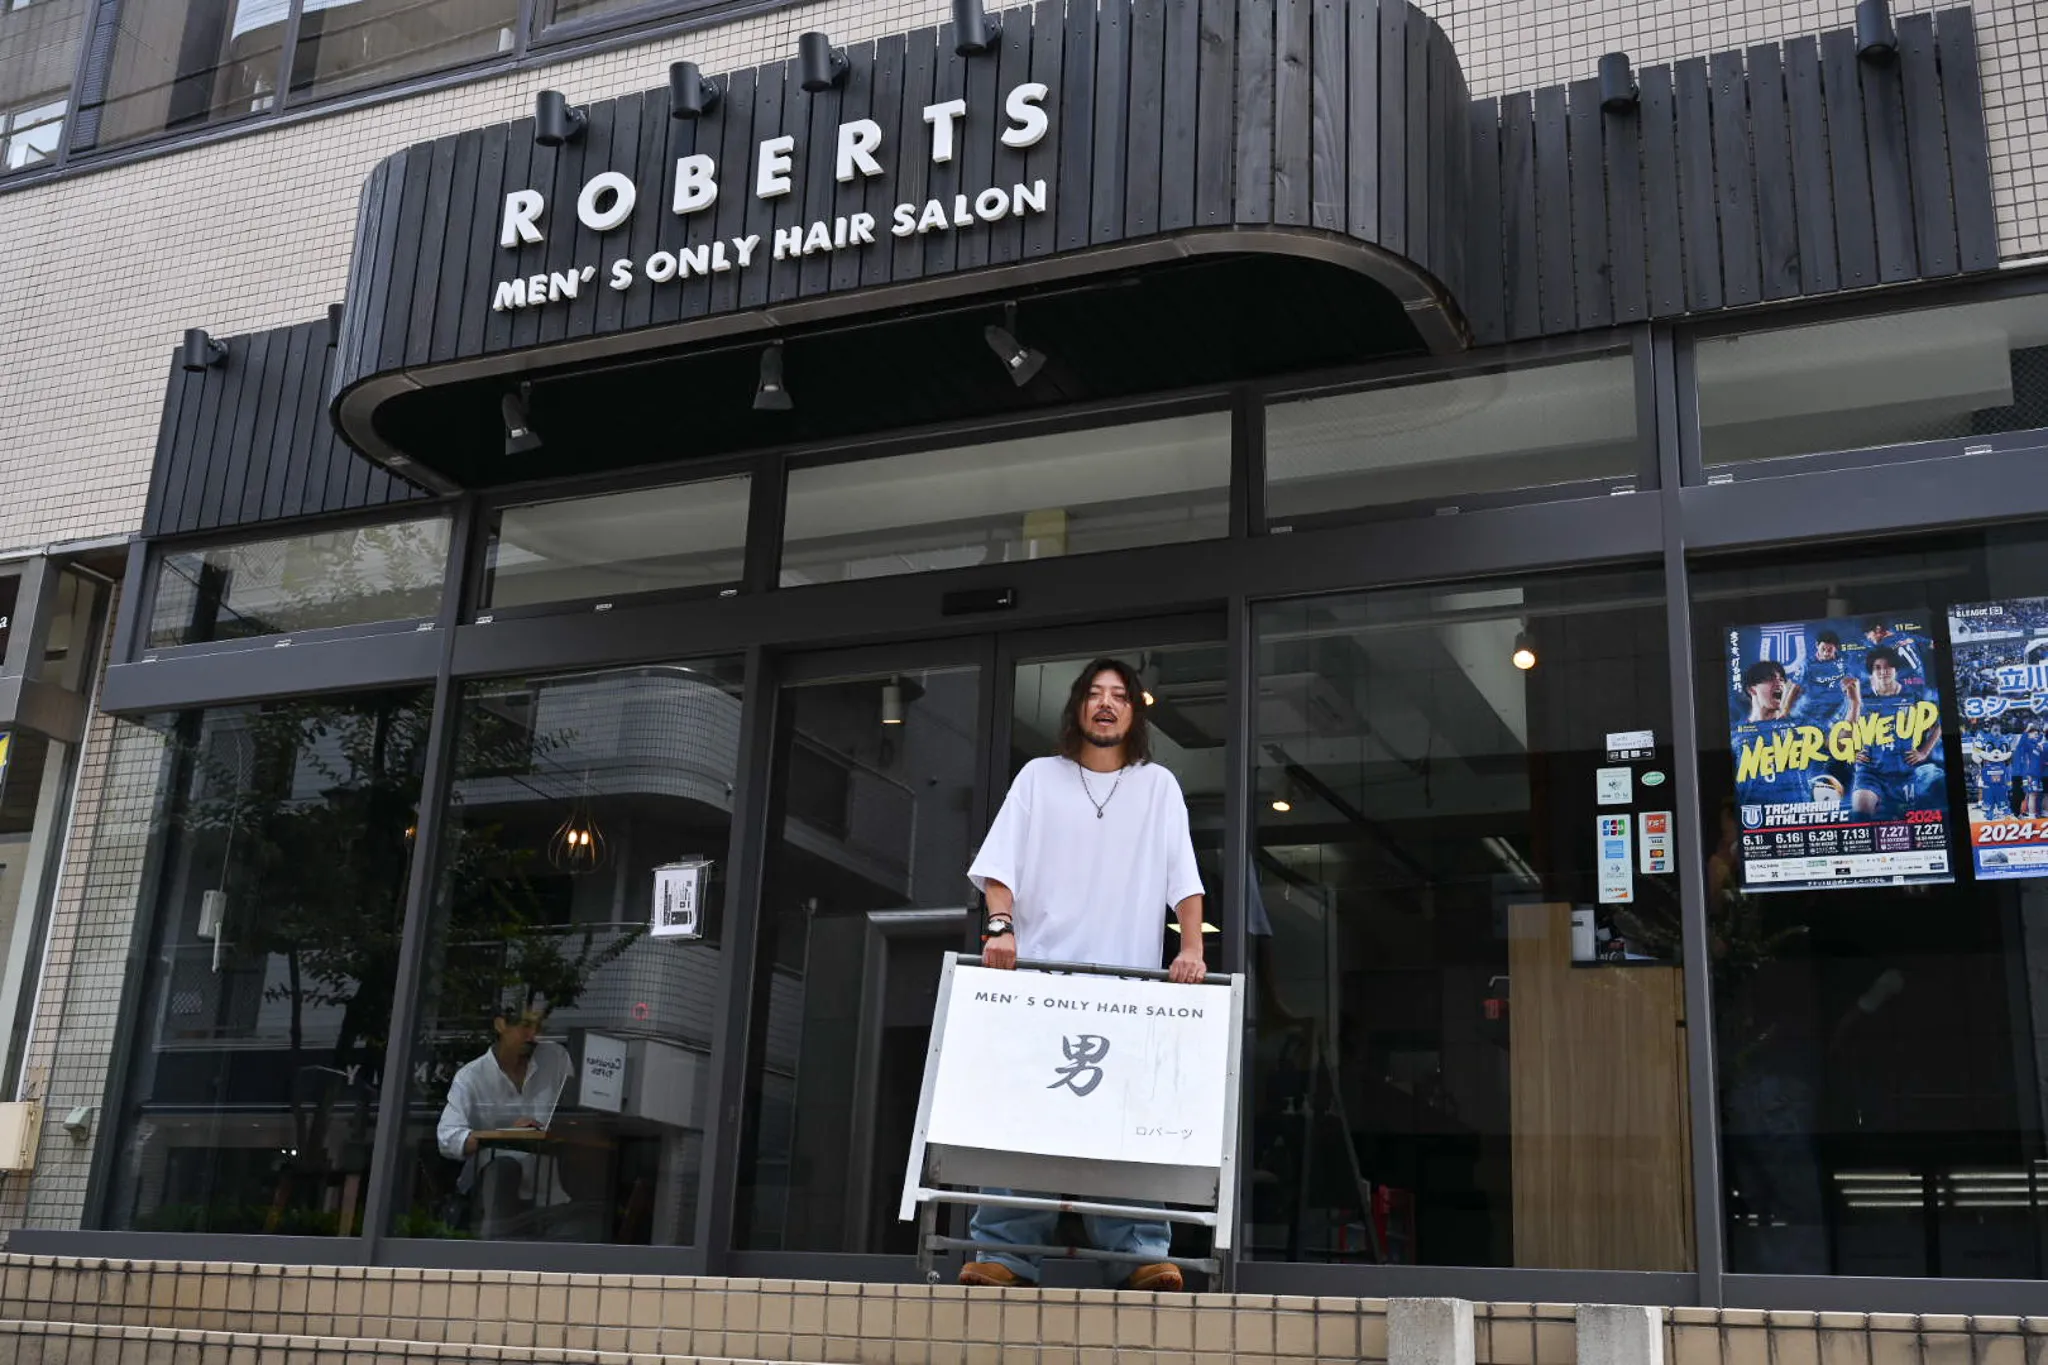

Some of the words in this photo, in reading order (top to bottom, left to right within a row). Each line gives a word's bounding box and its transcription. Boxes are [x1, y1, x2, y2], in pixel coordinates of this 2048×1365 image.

[500, 83, 1049, 249] ROBERTS
[645, 233, 760, 284] ONLY
[773, 211, 876, 261] HAIR
[891, 178, 1047, 237] SALON
[1736, 725, 1830, 784] NEVER
[1829, 712, 1896, 765] GIVE
[1896, 701, 1939, 750] UP
[1766, 811, 1829, 826] ATHLETIC
[1830, 810, 1849, 822] FC
[1905, 809, 1943, 824] 2024
[1808, 830, 1834, 842] 6.29
[1841, 828, 1866, 840] 7.13
[1880, 826, 1905, 838] 7.27
[1914, 823, 1940, 836] 7.27
[1775, 832, 1800, 844] 6.16
[1044, 998, 1090, 1011] ONLY
[1097, 1001, 1138, 1015] HAIR
[1146, 1006, 1204, 1019] SALON
[1046, 1033, 1111, 1098] 男
[1135, 1125, 1193, 1140] ロバーツ
